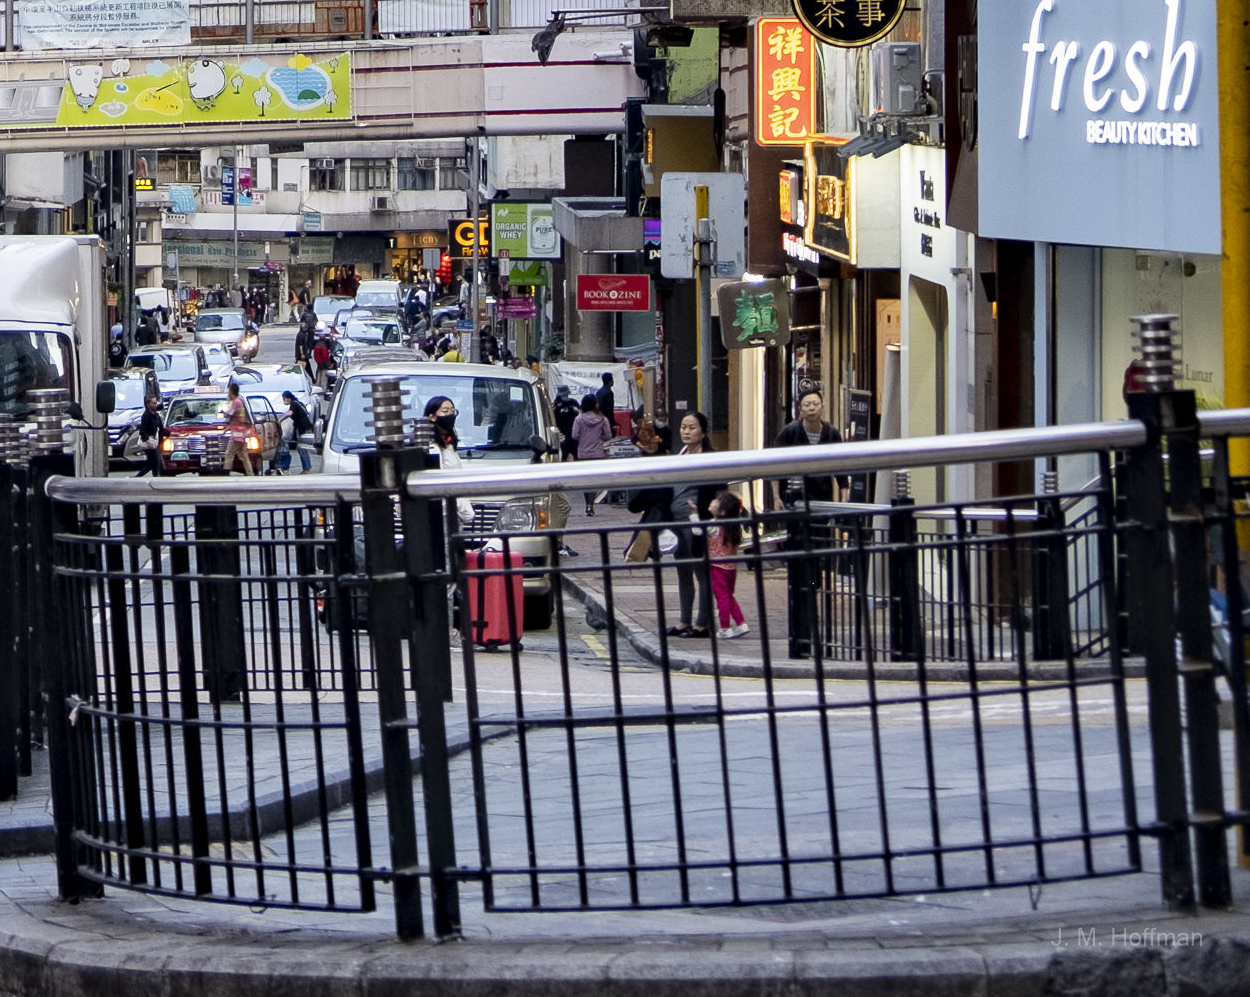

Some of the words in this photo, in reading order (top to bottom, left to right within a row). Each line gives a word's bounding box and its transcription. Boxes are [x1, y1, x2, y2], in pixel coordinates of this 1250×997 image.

[768, 26, 807, 138] 祥興記
[1086, 120, 1137, 144] BEAUTY
[1137, 122, 1198, 146] KITCHEN
[495, 222, 526, 231] ORGANIC
[499, 230, 522, 239] WHEY
[1185, 364, 1214, 383] Lunar
